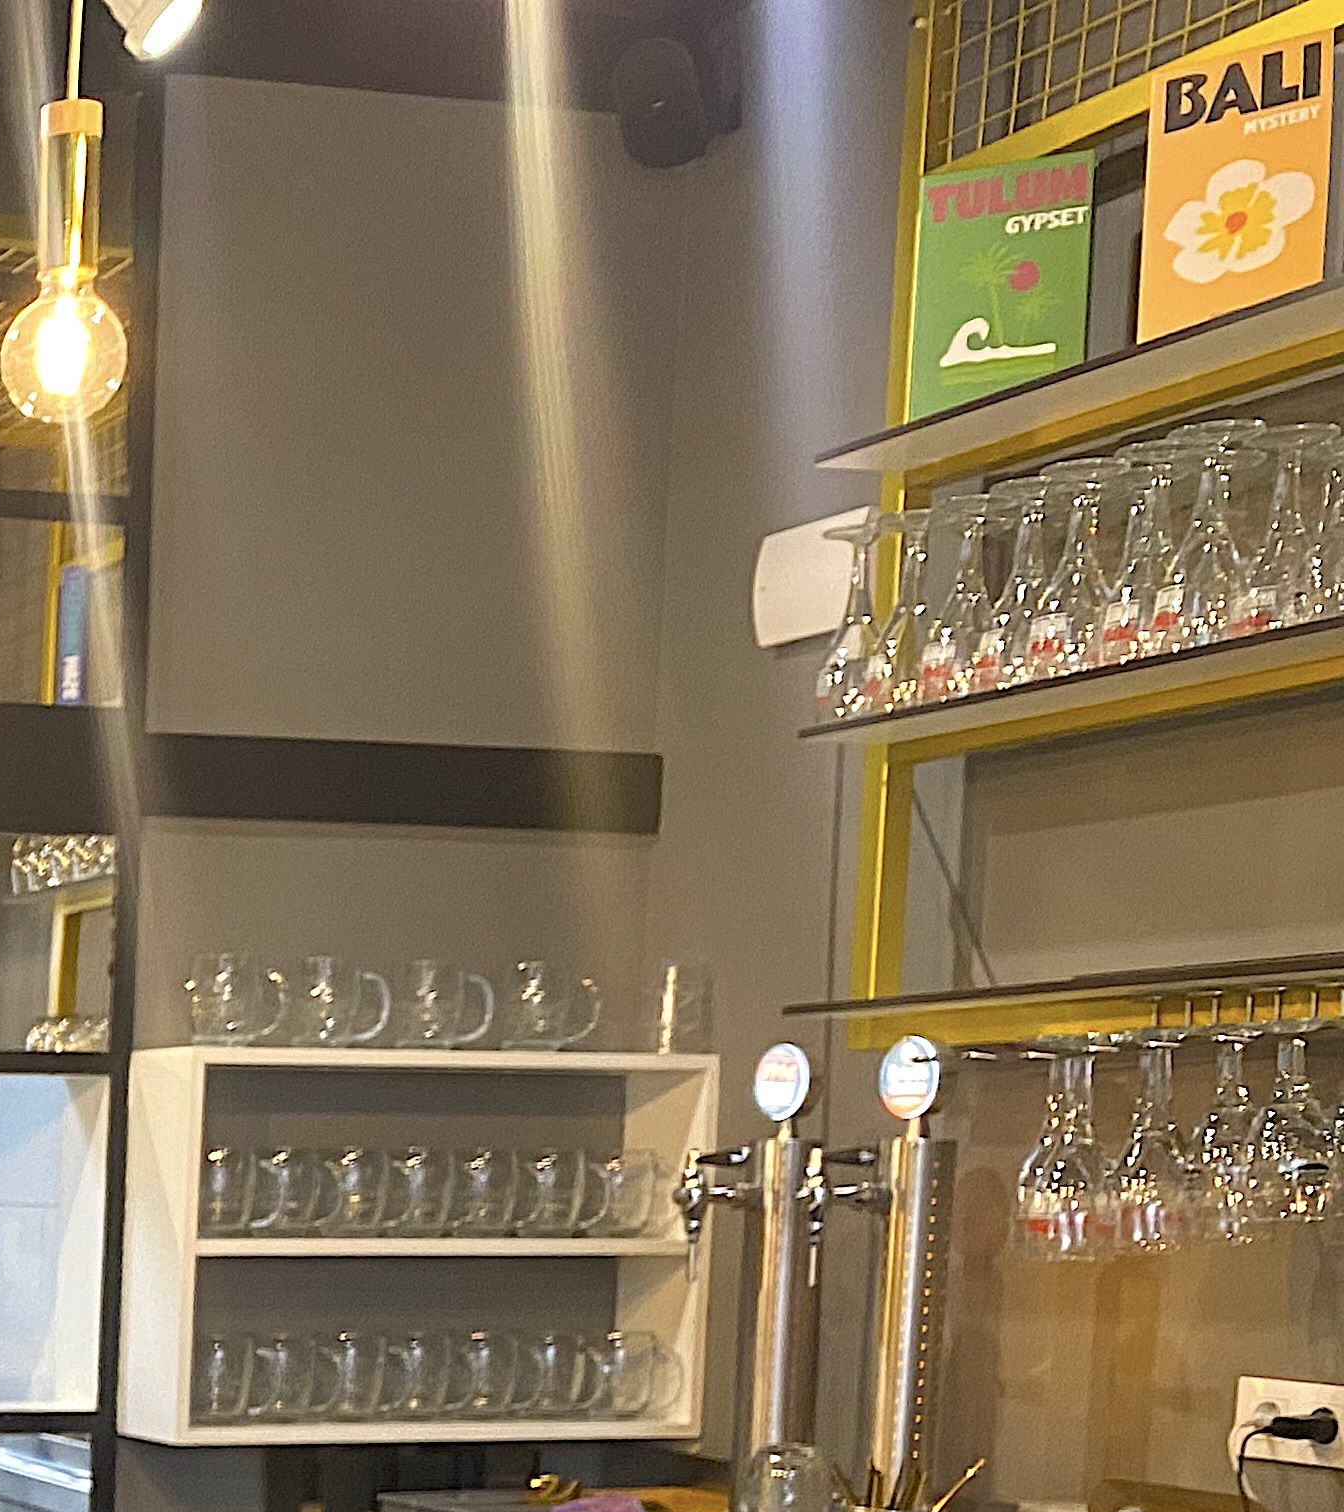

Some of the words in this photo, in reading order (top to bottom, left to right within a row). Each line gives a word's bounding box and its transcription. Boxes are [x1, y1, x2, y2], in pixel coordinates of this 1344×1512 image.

[1164, 41, 1323, 134] BALI
[1242, 103, 1323, 136] MYSTERY
[927, 162, 1090, 225] TULUM
[1005, 204, 1089, 235] GYPSET
